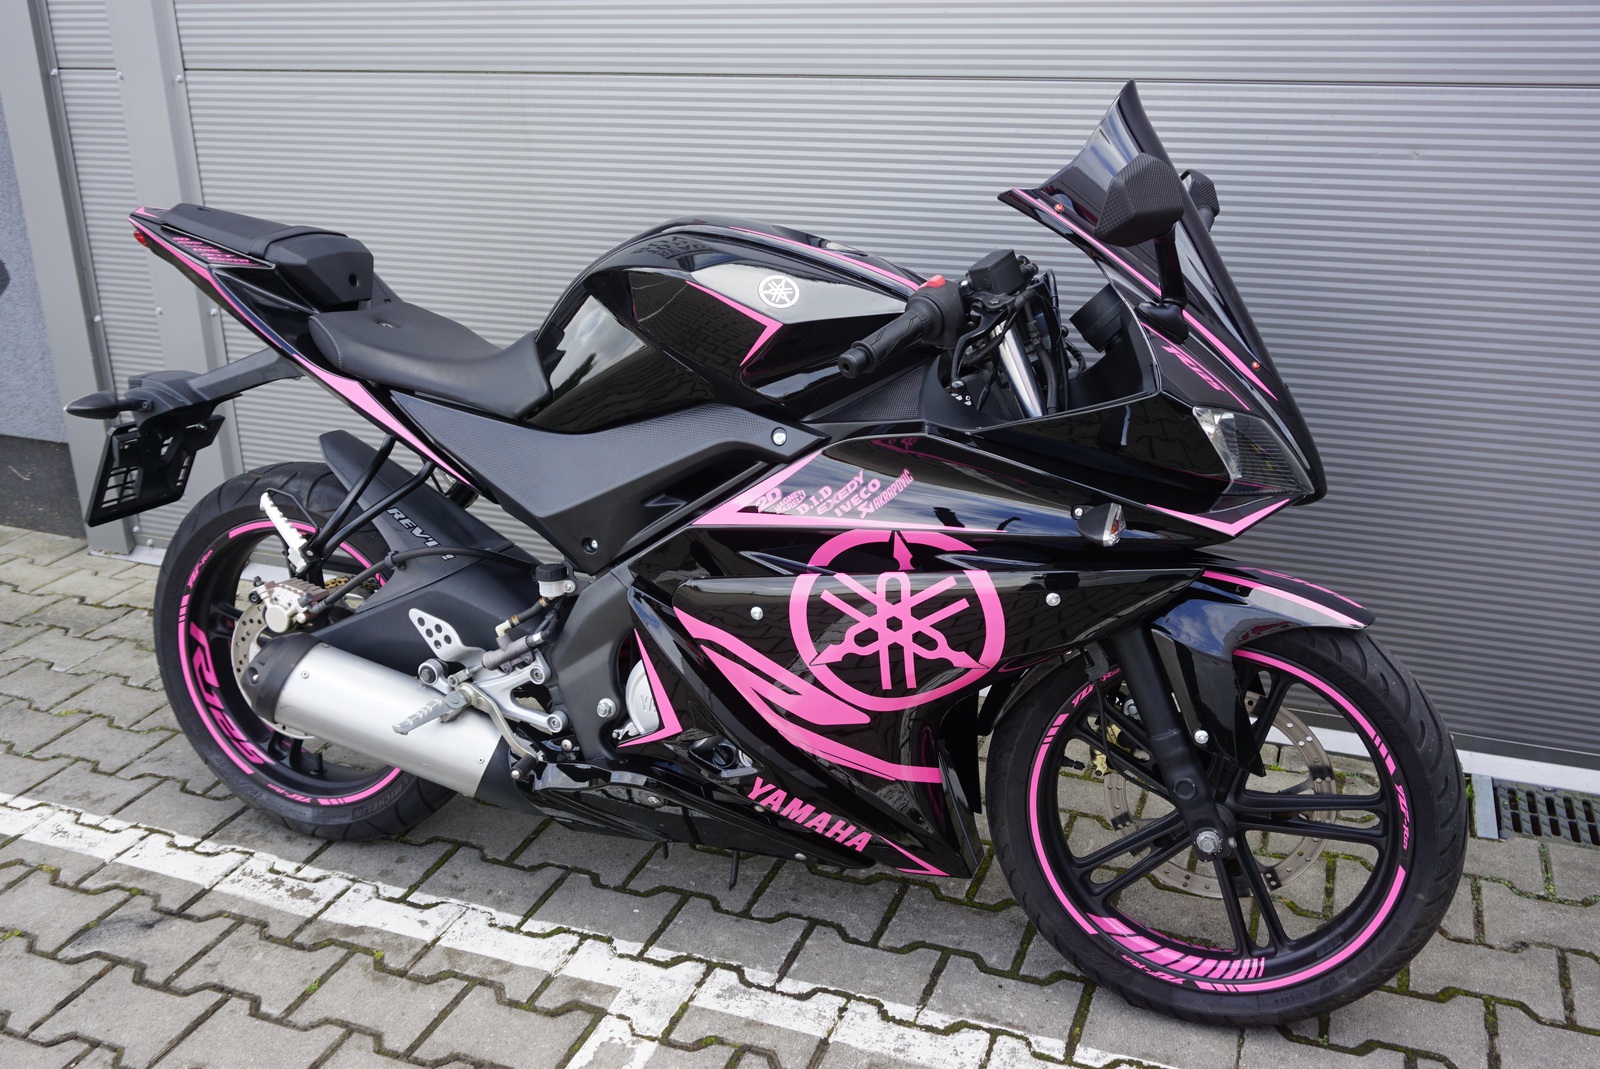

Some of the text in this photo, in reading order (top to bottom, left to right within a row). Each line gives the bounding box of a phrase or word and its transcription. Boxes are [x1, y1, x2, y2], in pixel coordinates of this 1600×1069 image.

[755, 487, 782, 513] 2D
[796, 485, 833, 516] D.I.D
[816, 469, 864, 516] EXEDY
[834, 478, 881, 518] IVECO
[747, 776, 872, 852] YAMAHA
